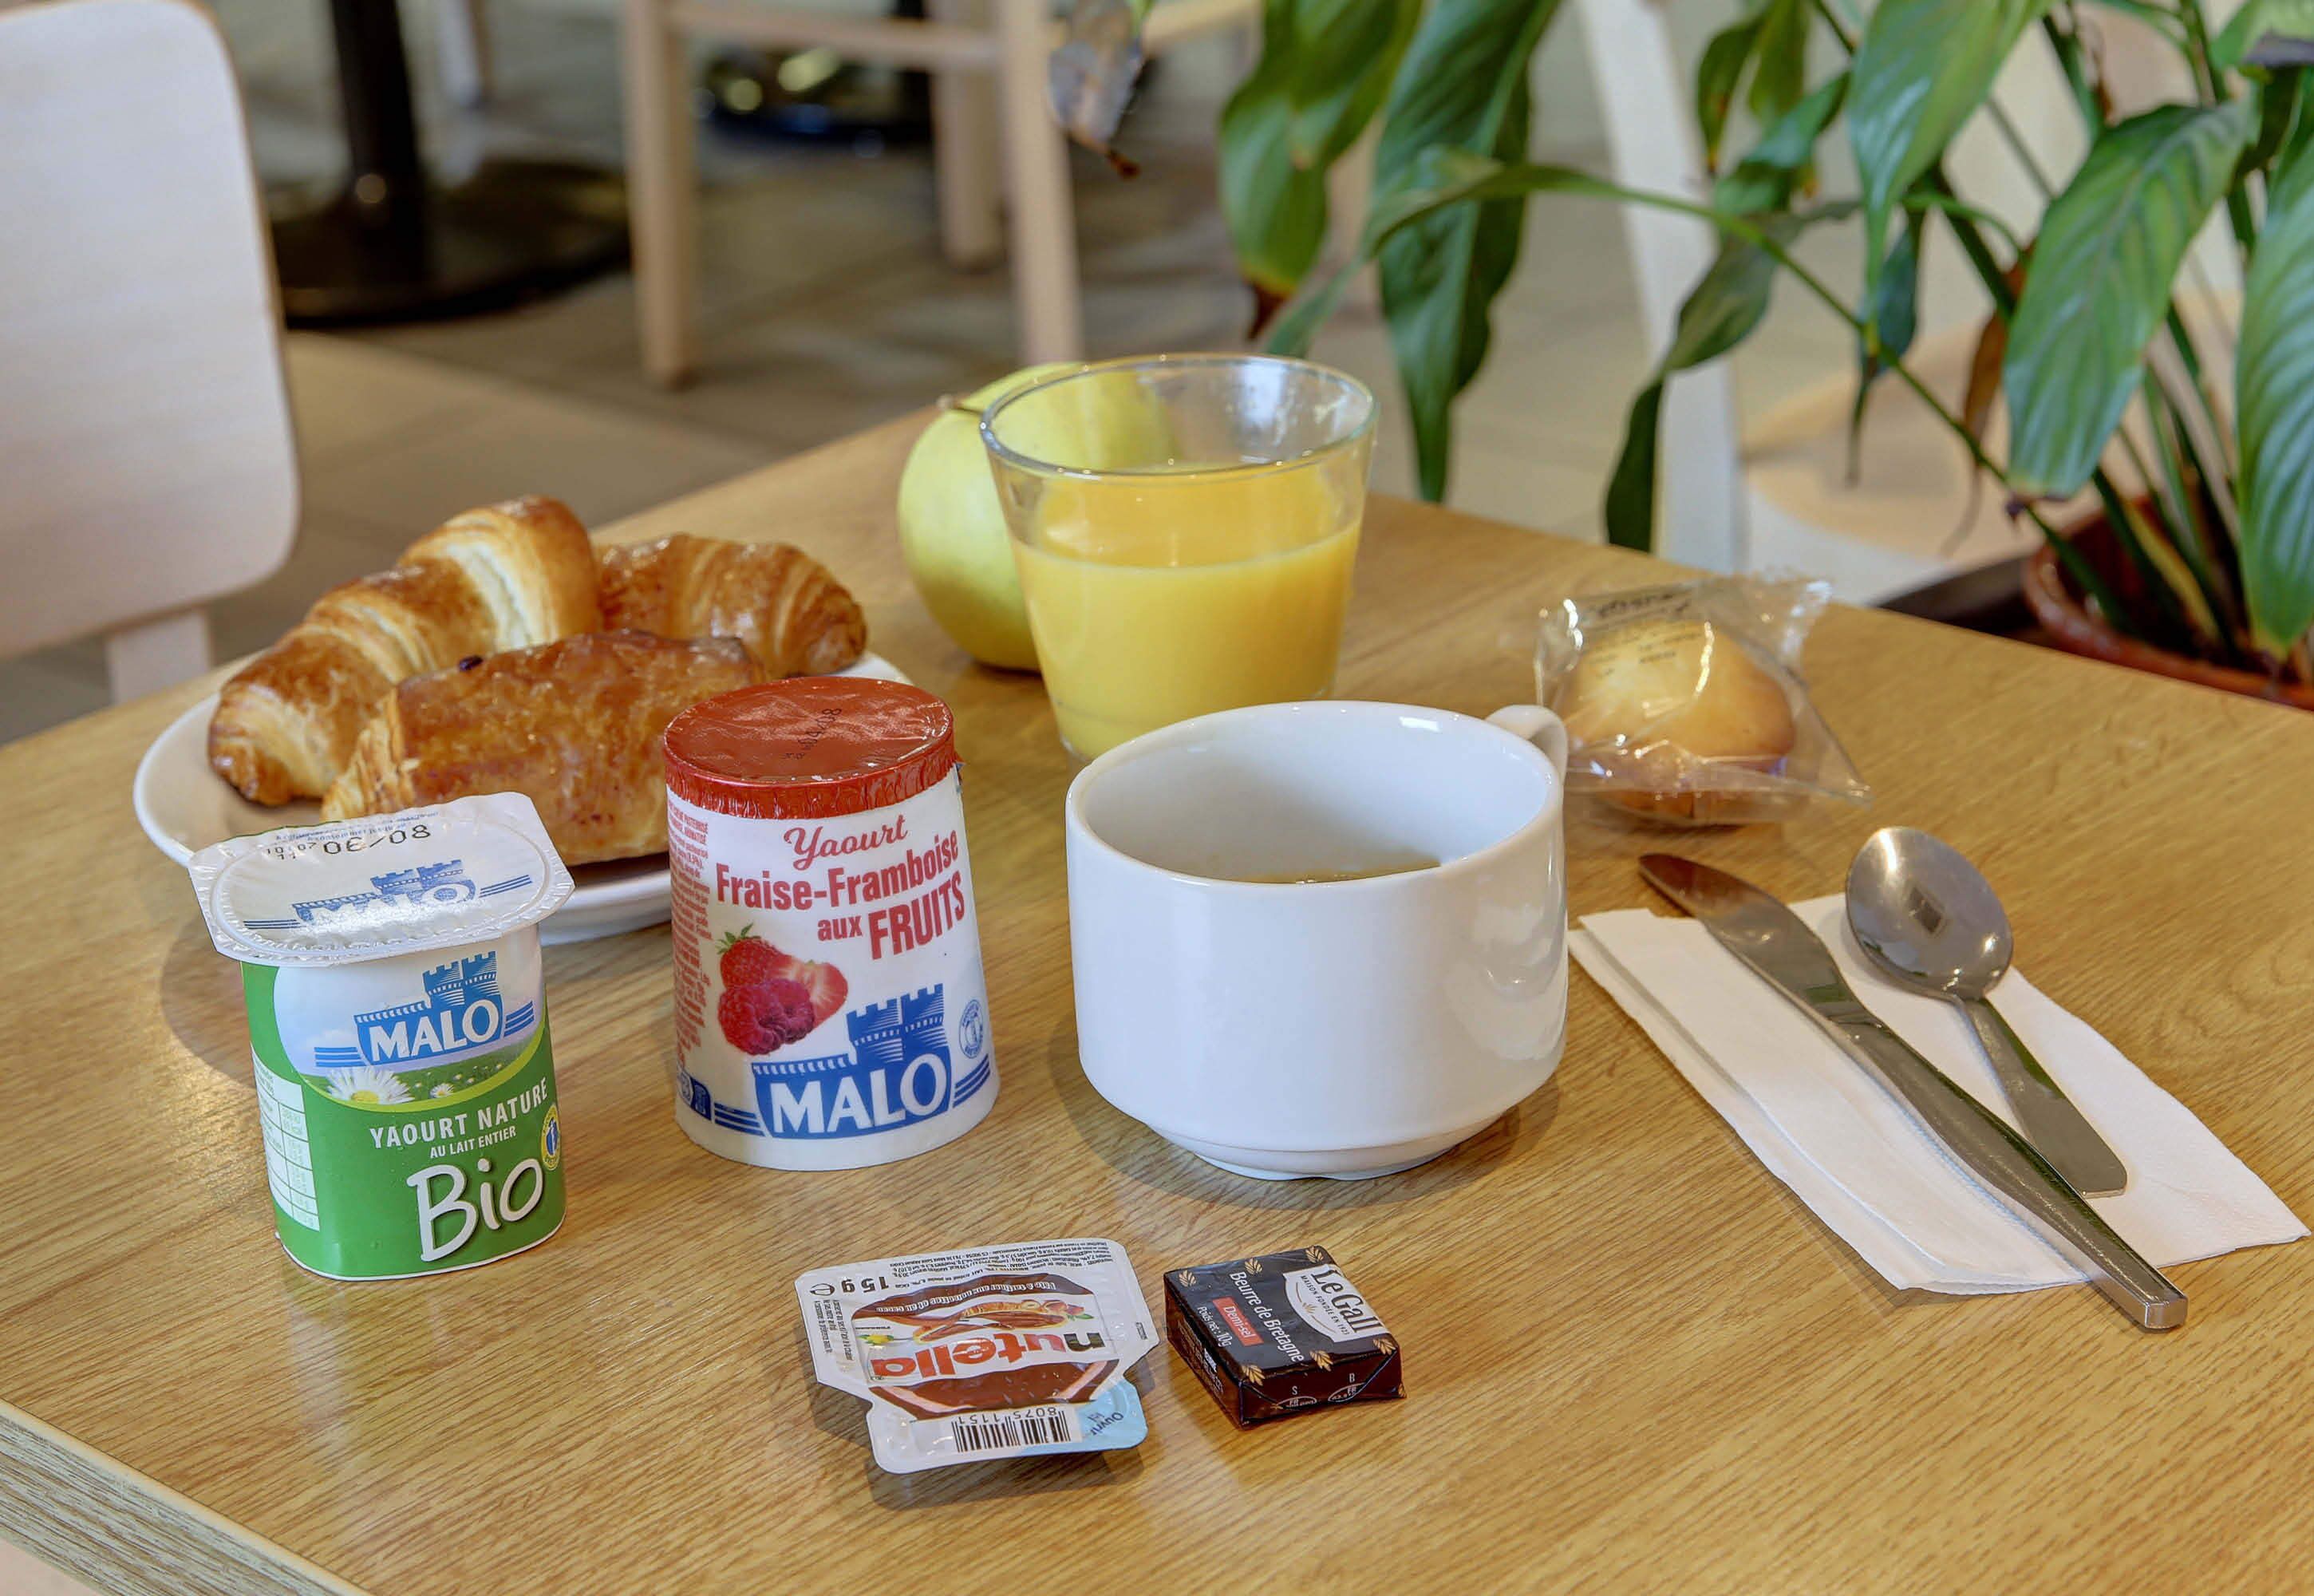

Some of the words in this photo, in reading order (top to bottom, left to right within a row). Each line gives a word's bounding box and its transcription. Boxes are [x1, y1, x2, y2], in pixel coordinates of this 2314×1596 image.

[784, 814, 907, 871] Yaourt
[717, 829, 958, 911] Fraise-Framboise
[818, 915, 863, 942] aux
[868, 871, 965, 960] FRUITS
[369, 1000, 500, 1062] MALO
[769, 1053, 947, 1136] MALO
[369, 1114, 468, 1150] YAOURT
[477, 1077, 548, 1131] NATURE
[430, 1146, 445, 1159] AU
[449, 1139, 475, 1156] LAIT
[479, 1125, 517, 1149] ENTIER
[406, 1157, 543, 1262] Bio
[841, 1278, 855, 1293] g
[861, 1276, 889, 1293] 15
[1230, 1271, 1262, 1306] Beurre
[1301, 1275, 1318, 1295] MAISON
[1311, 1270, 1344, 1294] Le
[1331, 1294, 1384, 1333] Gall
[1222, 1306, 1257, 1338] Demi-sel
[1254, 1306, 1273, 1319] de
[871, 1332, 1105, 1379] nutella
[1263, 1319, 1305, 1362] Bretagne
[1292, 1385, 1298, 1396] S
[1349, 1373, 1356, 1383] B
[958, 1412, 1001, 1425] 1151
[1015, 1407, 1057, 1420] 8075
[1090, 1411, 1124, 1436] Ouvrir
